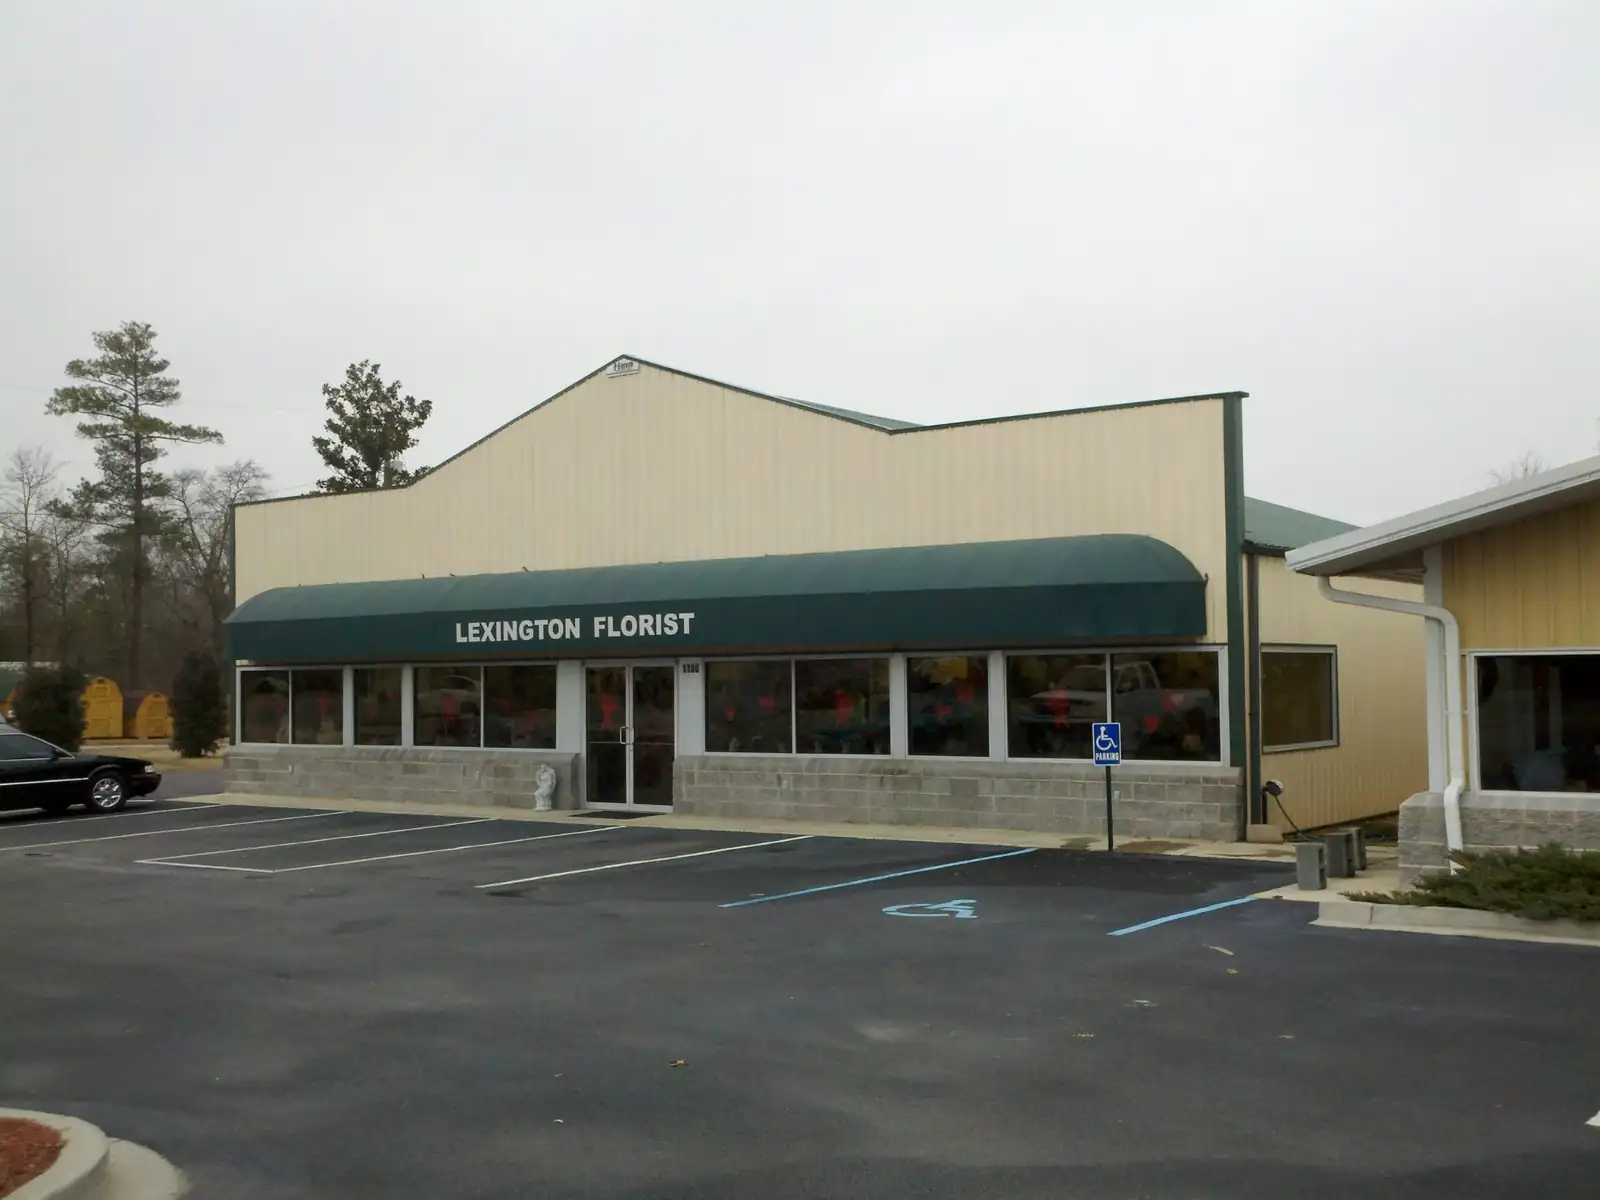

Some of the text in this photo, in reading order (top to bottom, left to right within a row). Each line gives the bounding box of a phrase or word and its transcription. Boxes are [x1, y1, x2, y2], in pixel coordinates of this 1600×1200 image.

[456, 612, 694, 643] LEXINGTON FLORIST
[1095, 752, 1120, 761] PARKING
